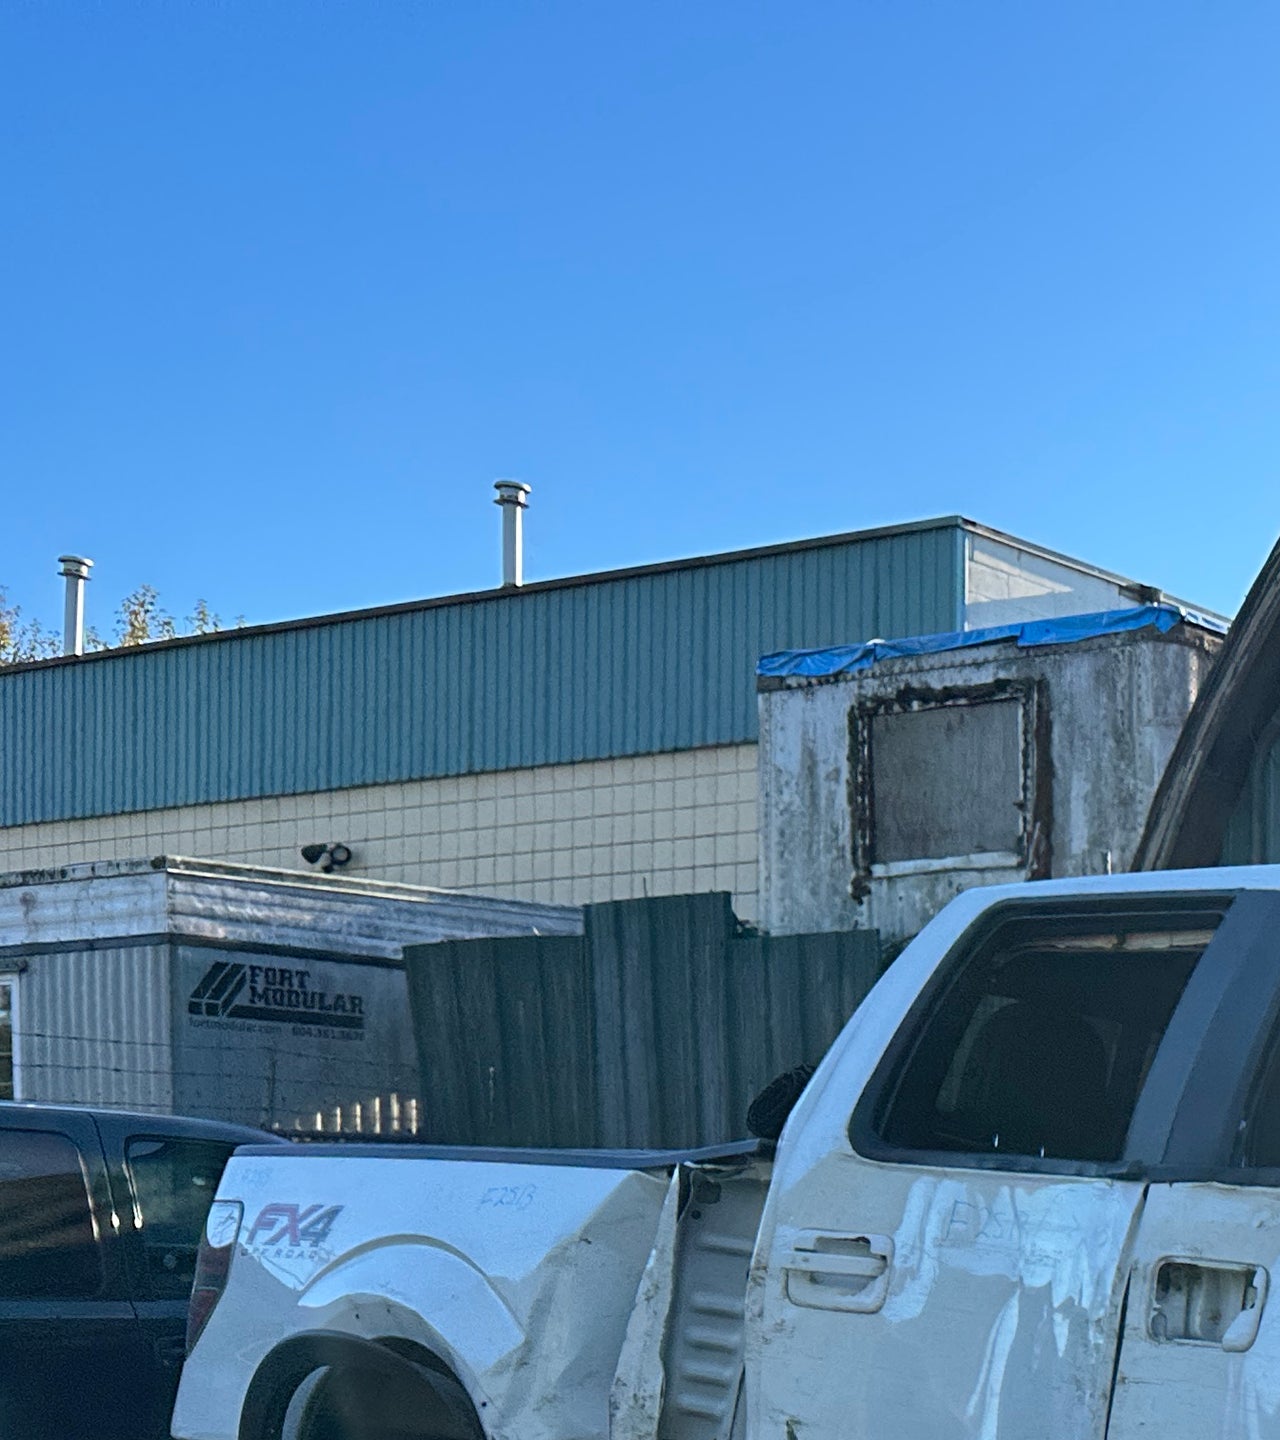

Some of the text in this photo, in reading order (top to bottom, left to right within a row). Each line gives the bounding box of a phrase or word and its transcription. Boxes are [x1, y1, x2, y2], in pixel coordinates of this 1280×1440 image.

[249, 965, 311, 989] FORT
[249, 985, 365, 1014] MODULAR
[245, 1201, 346, 1247] FX4
